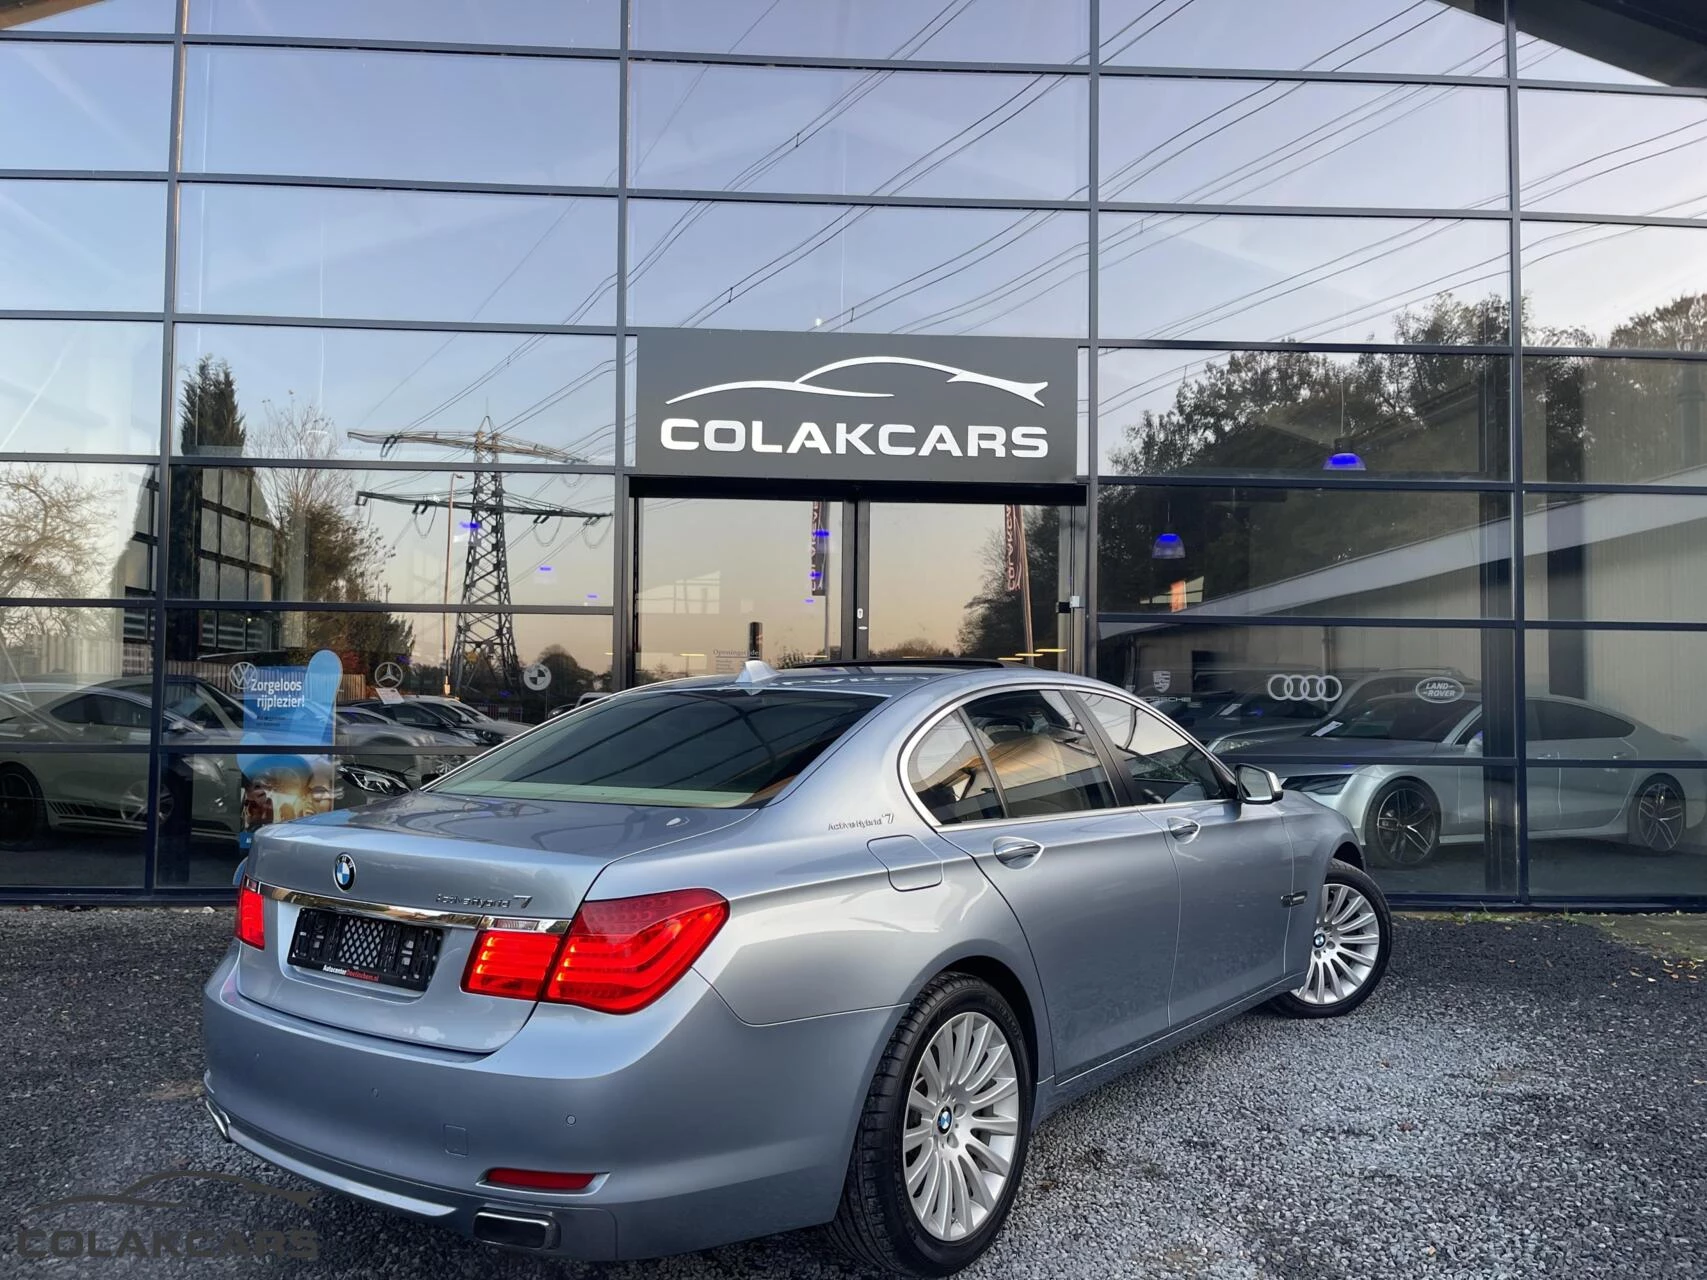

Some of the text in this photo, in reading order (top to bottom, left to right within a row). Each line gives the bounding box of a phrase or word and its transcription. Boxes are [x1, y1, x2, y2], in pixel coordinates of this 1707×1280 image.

[660, 418, 1049, 459] COLAKCARS
[251, 678, 303, 695] Zorgeloos
[1425, 682, 1449, 690] LAND
[257, 695, 305, 711] rijplezier!
[881, 813, 895, 824] 7
[512, 894, 534, 909] 7
